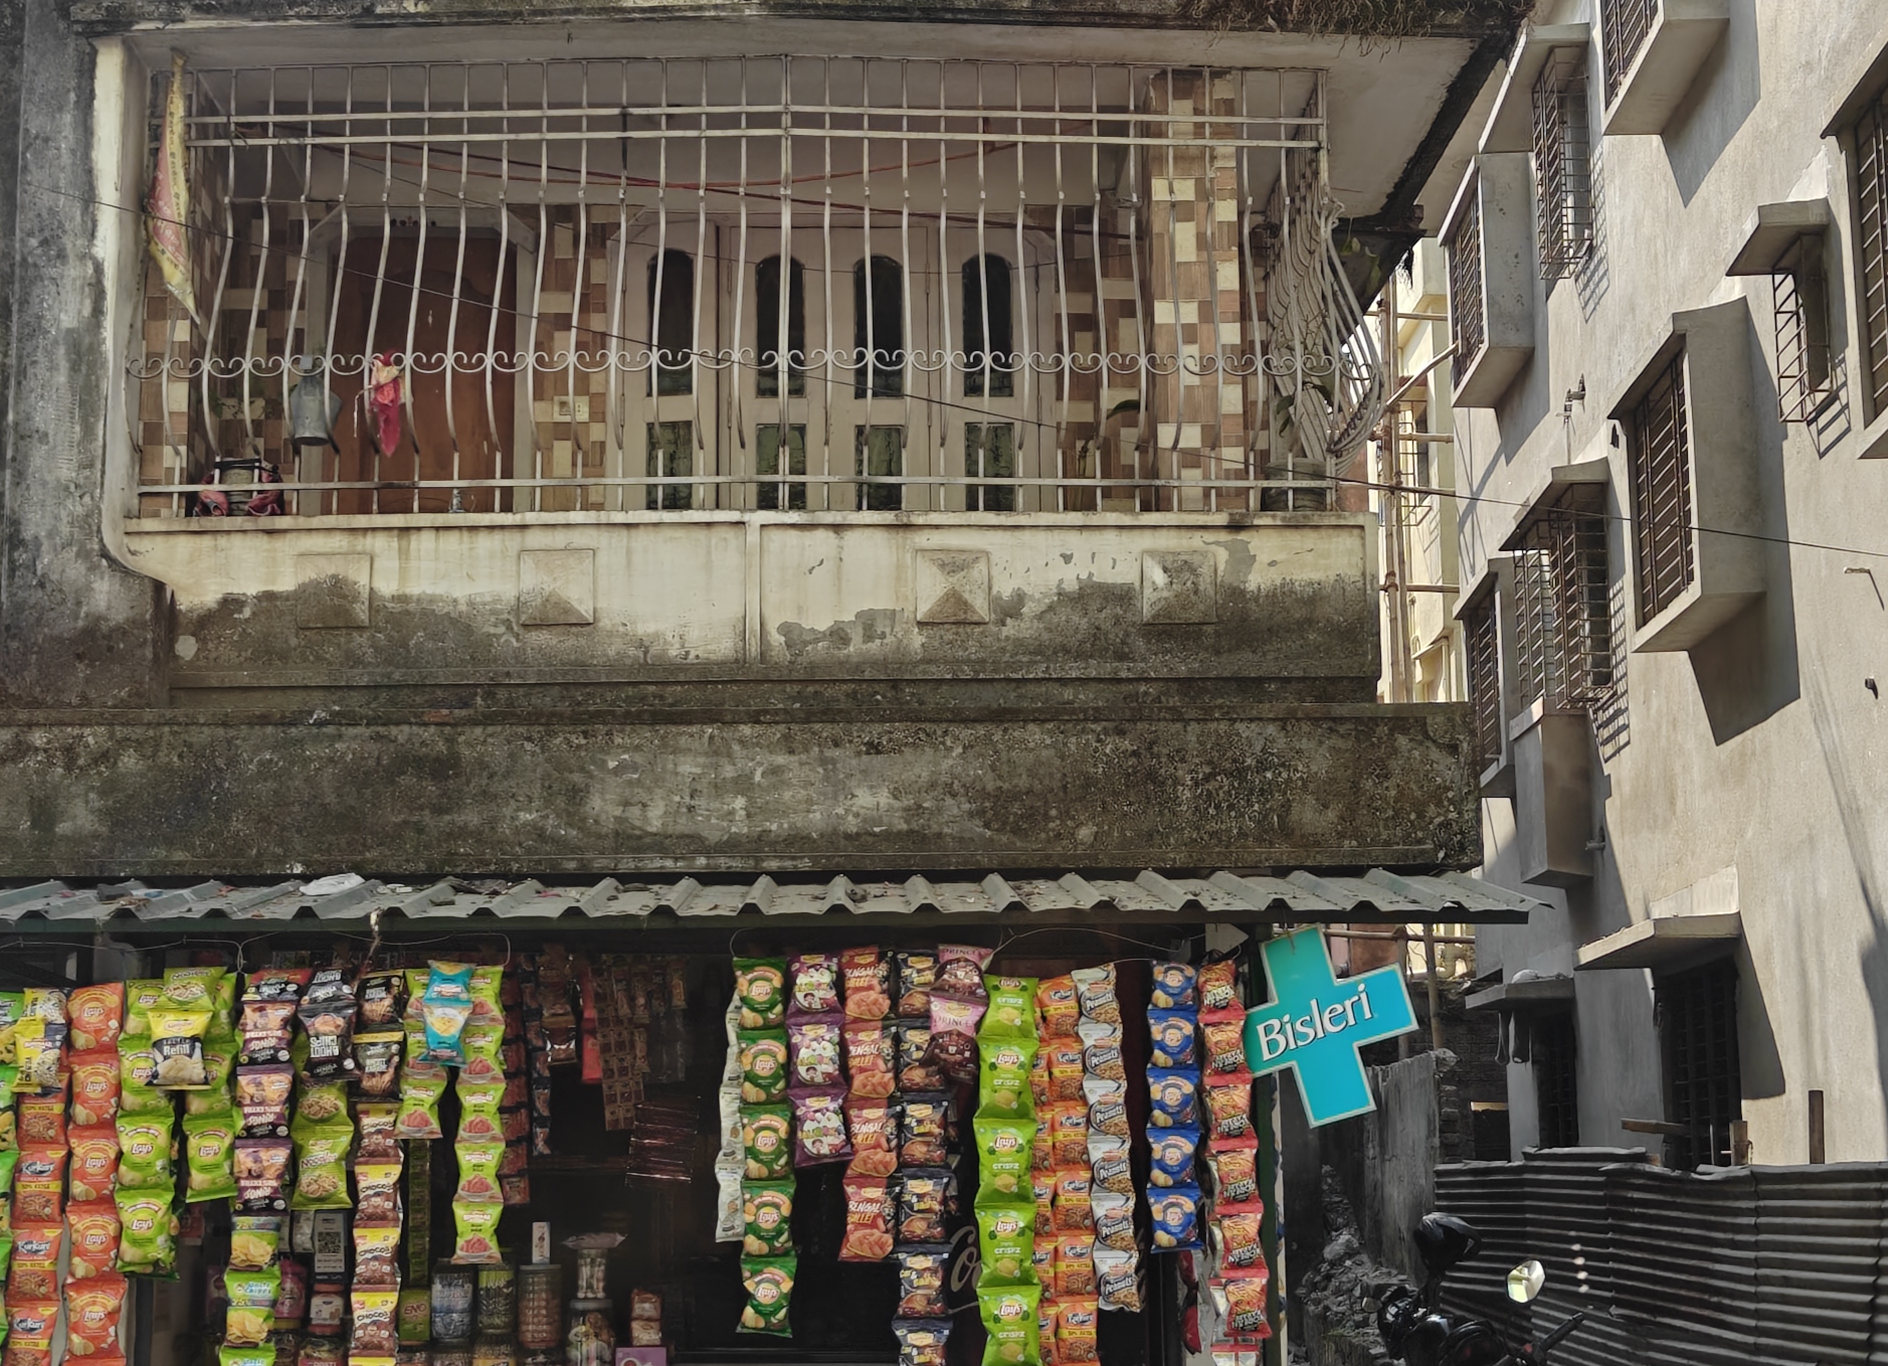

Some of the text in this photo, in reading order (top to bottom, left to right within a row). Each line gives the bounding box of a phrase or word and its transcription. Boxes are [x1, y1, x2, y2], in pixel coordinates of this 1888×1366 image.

[1256, 983, 1374, 1062] Bisleri
[163, 1044, 190, 1055] Refill
[404, 1302, 426, 1316] ENO
